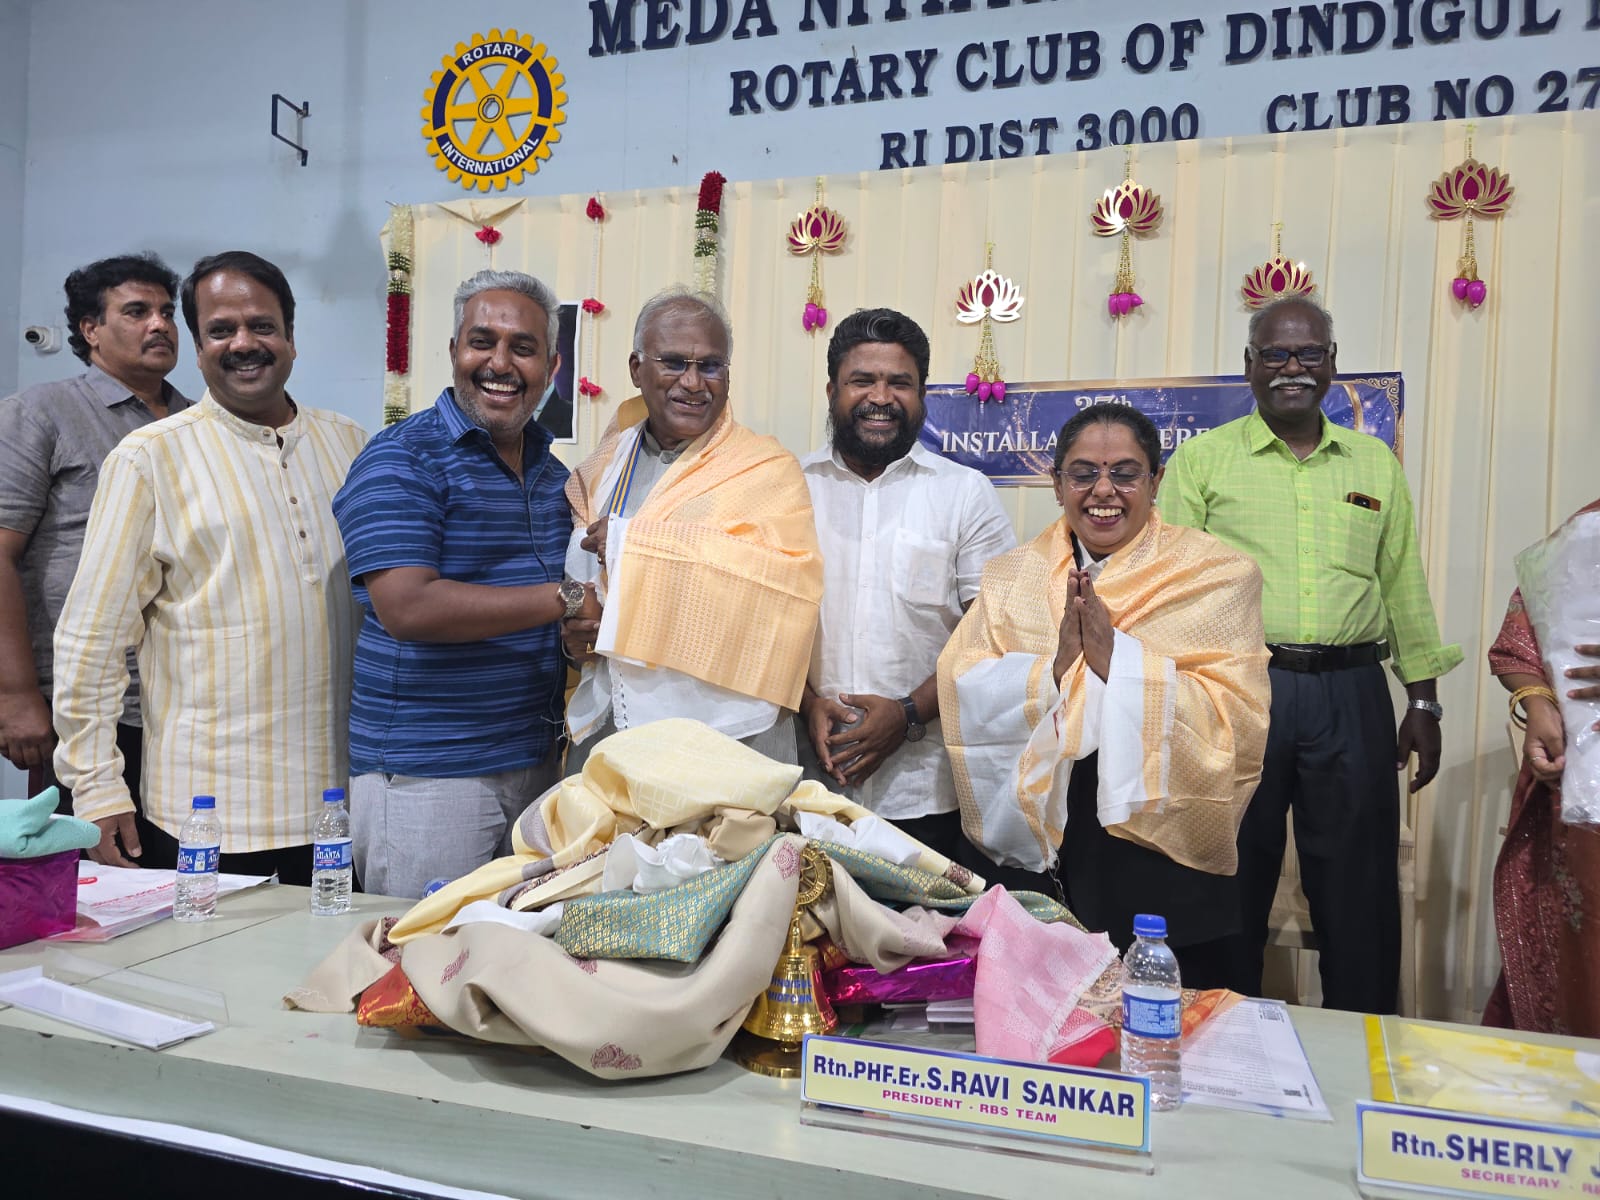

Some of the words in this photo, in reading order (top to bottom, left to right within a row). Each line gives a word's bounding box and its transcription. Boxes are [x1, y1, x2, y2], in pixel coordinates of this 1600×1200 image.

[588, 0, 778, 57] MEDA
[462, 43, 524, 66] ROTARY
[729, 48, 938, 116] ROTARY
[956, 30, 1101, 92] CLUB
[1125, 19, 1205, 74] OF
[1225, 0, 1561, 65] DINDIGUL
[879, 129, 928, 170] RI
[945, 117, 1059, 164] DIST
[1076, 102, 1199, 151] 3000
[1266, 84, 1411, 133] CLUB
[1433, 74, 1515, 121] NO
[441, 137, 539, 174] INTERNATIONAL
[942, 429, 1059, 453] INSTALLA
[882, 1089, 963, 1110] PRESIDENT
[979, 1103, 1009, 1116] RBS
[1015, 1108, 1057, 1124] TEAM
[1022, 1080, 1135, 1118] SANKAR
[1391, 1130, 1573, 1175] Rtn.SHERLY
[1460, 1167, 1560, 1189] SECRETARY
